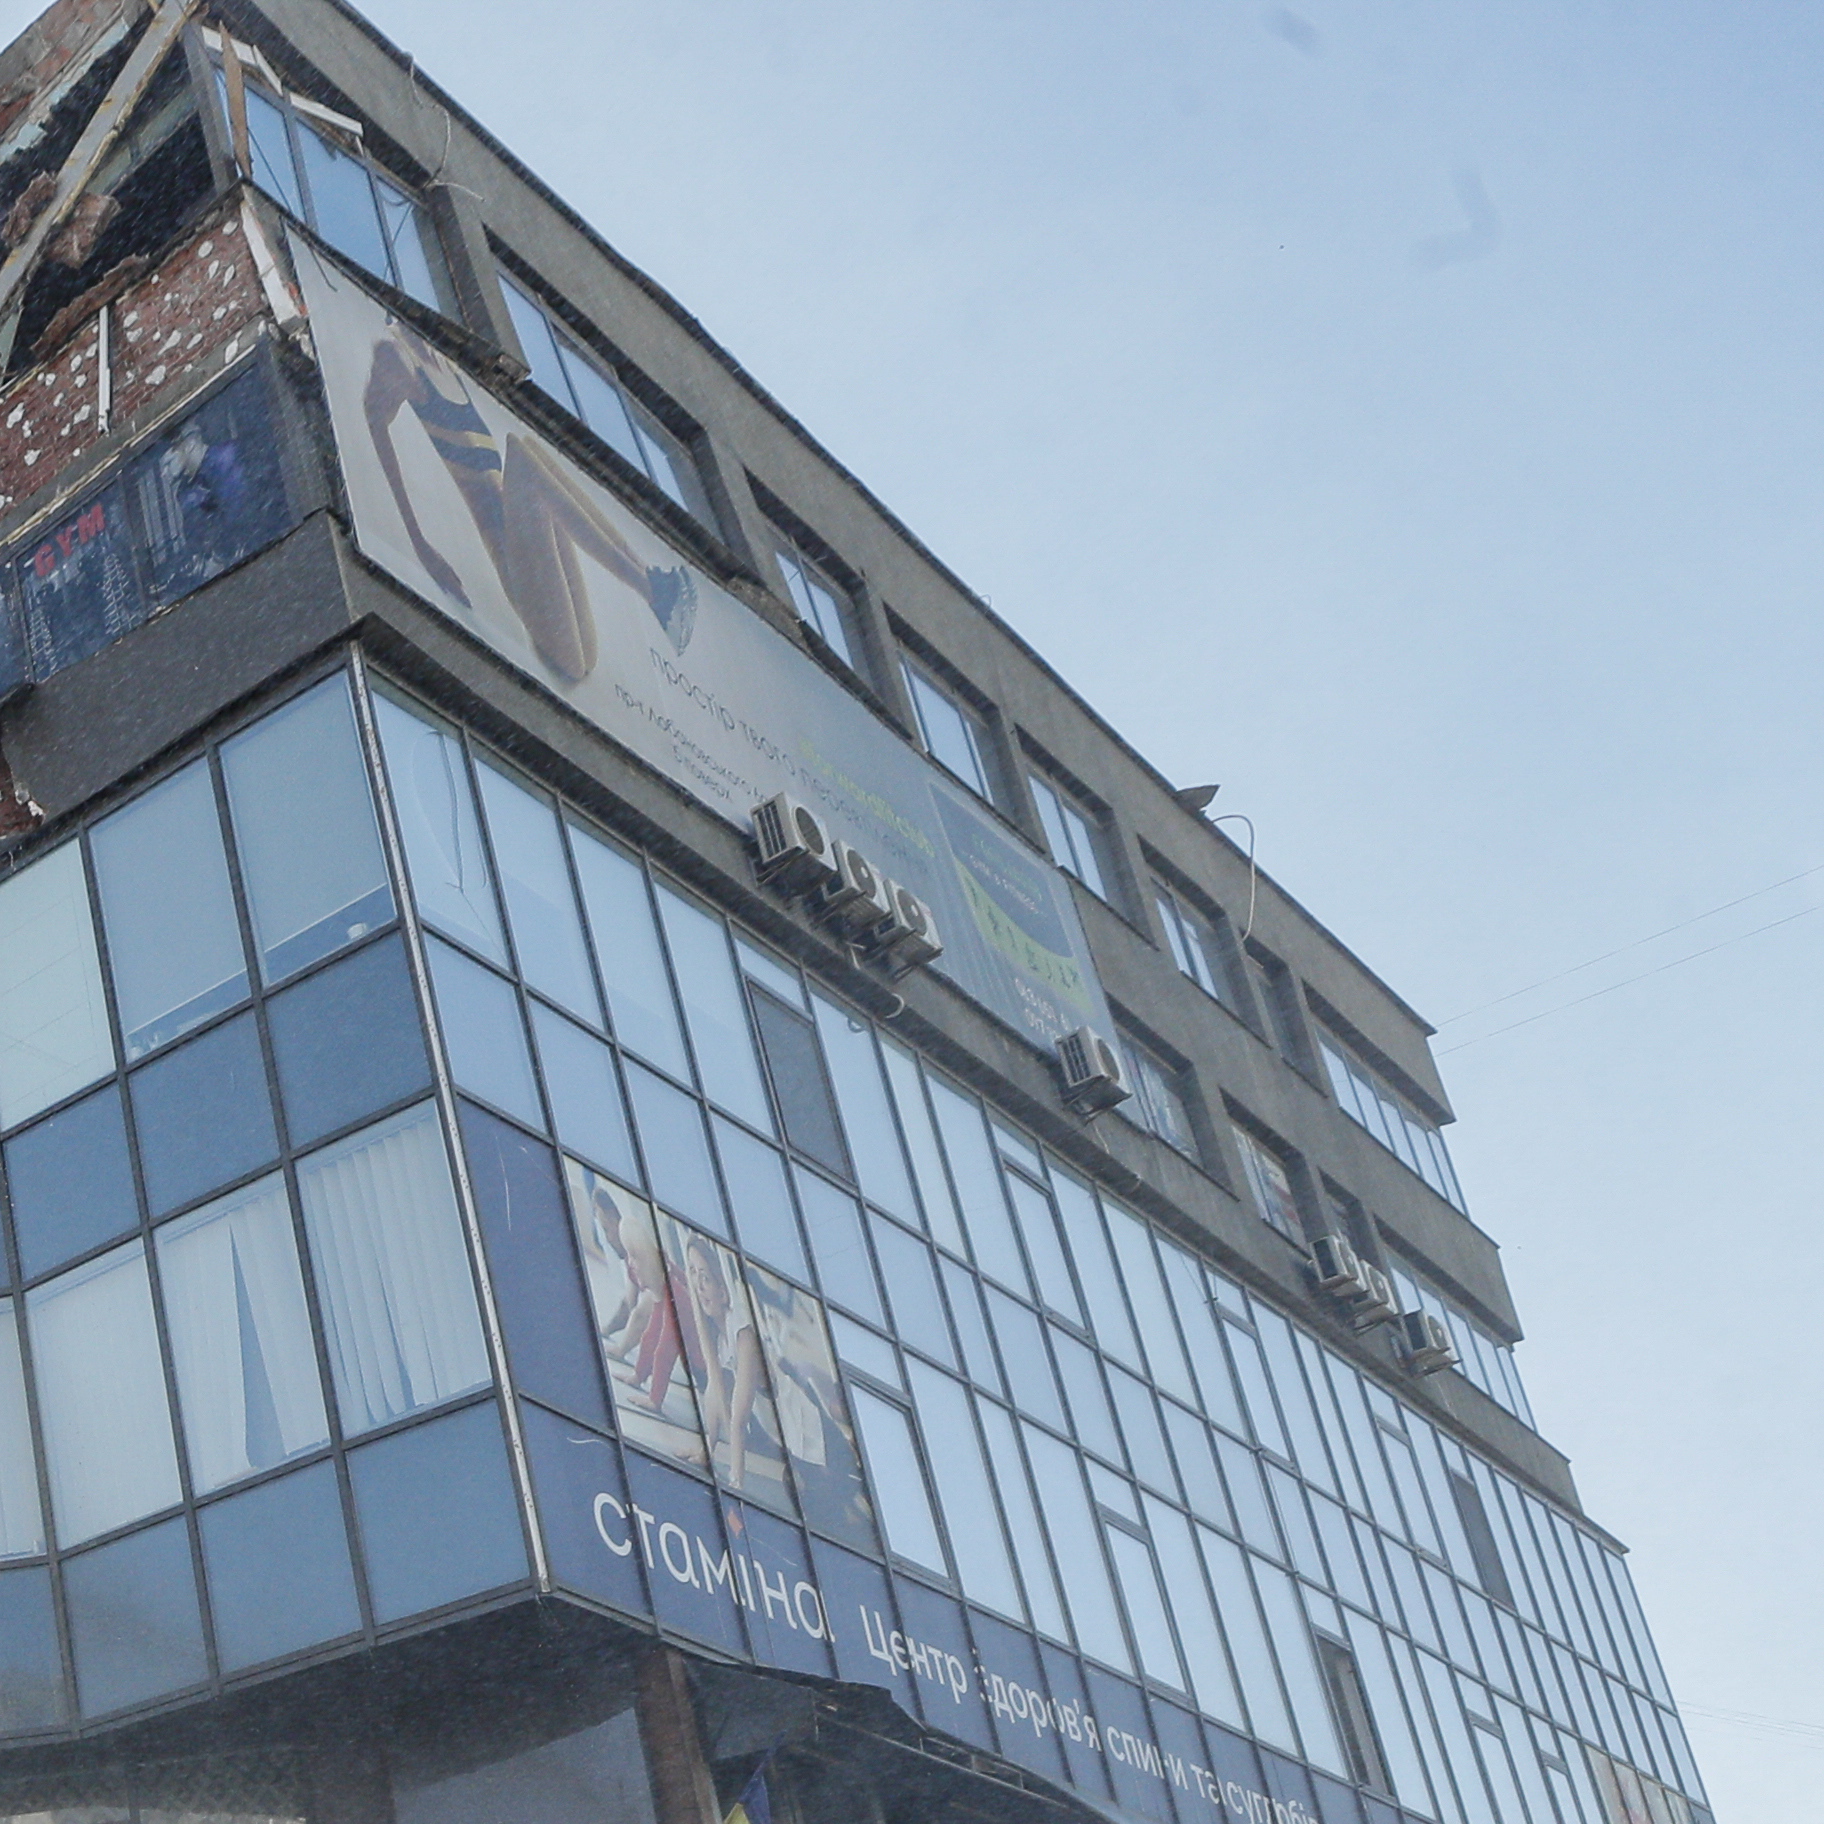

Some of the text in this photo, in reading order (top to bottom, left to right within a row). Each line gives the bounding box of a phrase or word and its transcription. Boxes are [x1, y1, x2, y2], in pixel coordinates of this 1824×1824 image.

[33, 503, 106, 578] GYM
[858, 1604, 970, 1705] Центр
[977, 1648, 1104, 1753] здоров'я
[1190, 1761, 1226, 1807] та
